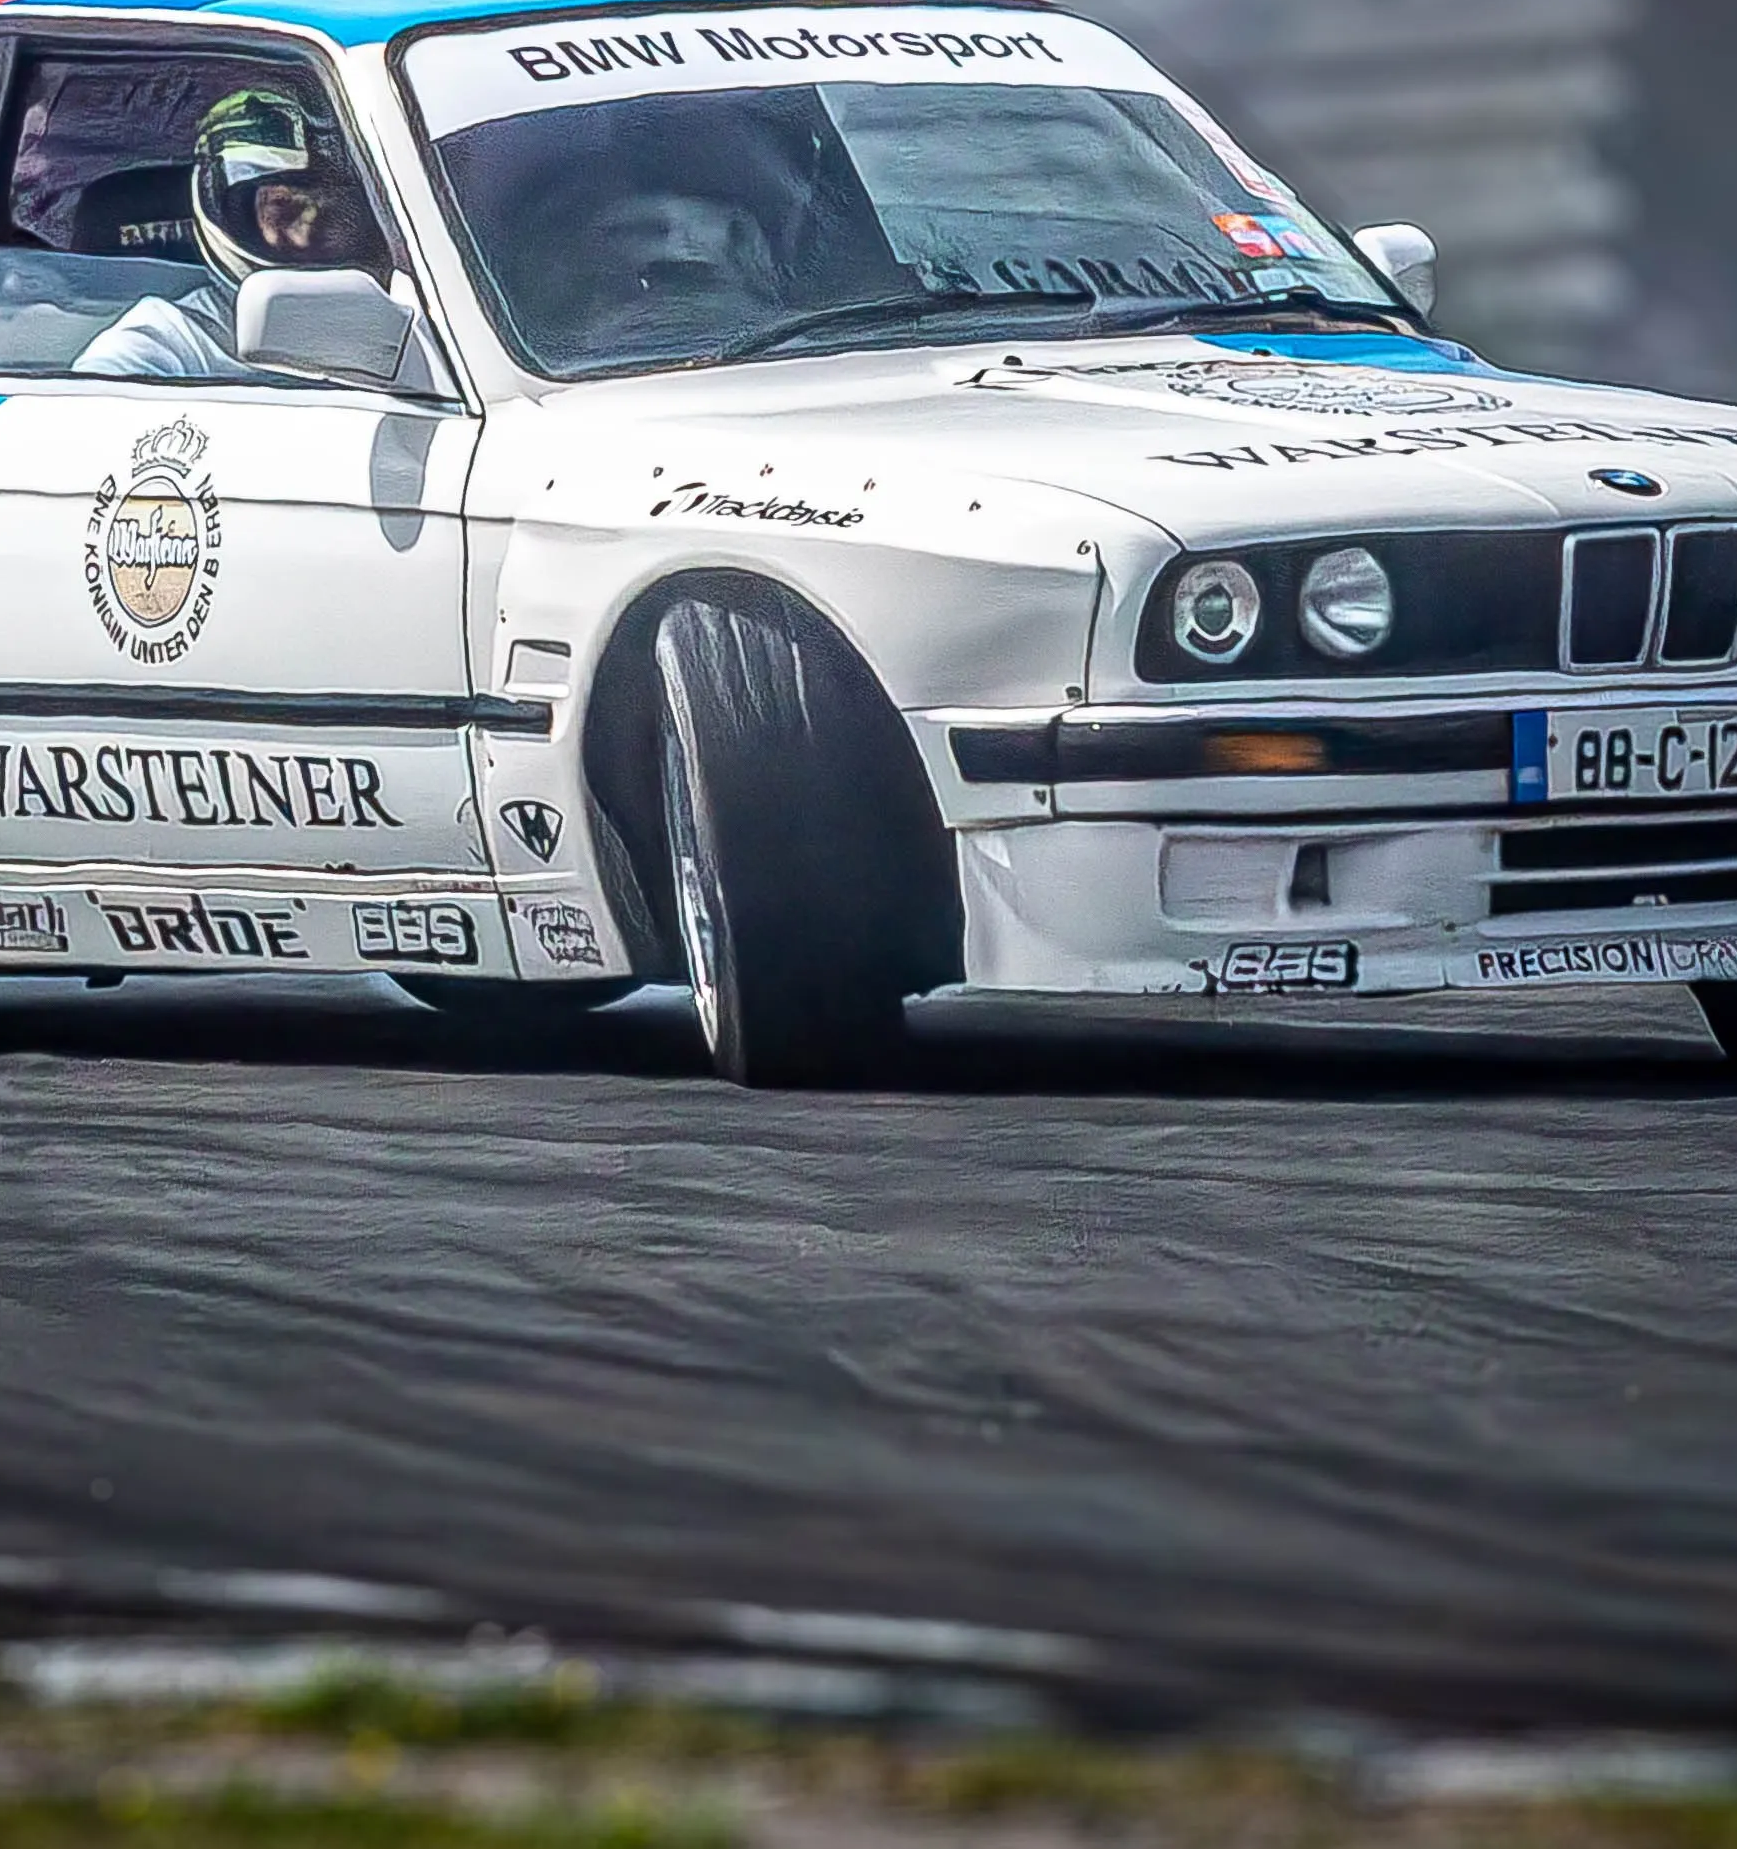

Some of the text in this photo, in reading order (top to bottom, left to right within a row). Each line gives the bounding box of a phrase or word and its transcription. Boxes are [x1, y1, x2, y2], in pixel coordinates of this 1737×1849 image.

[506, 27, 1063, 82] BMW Motorsport
[99, 892, 311, 959] BRIDE
[1477, 936, 1656, 980] PRECISION
